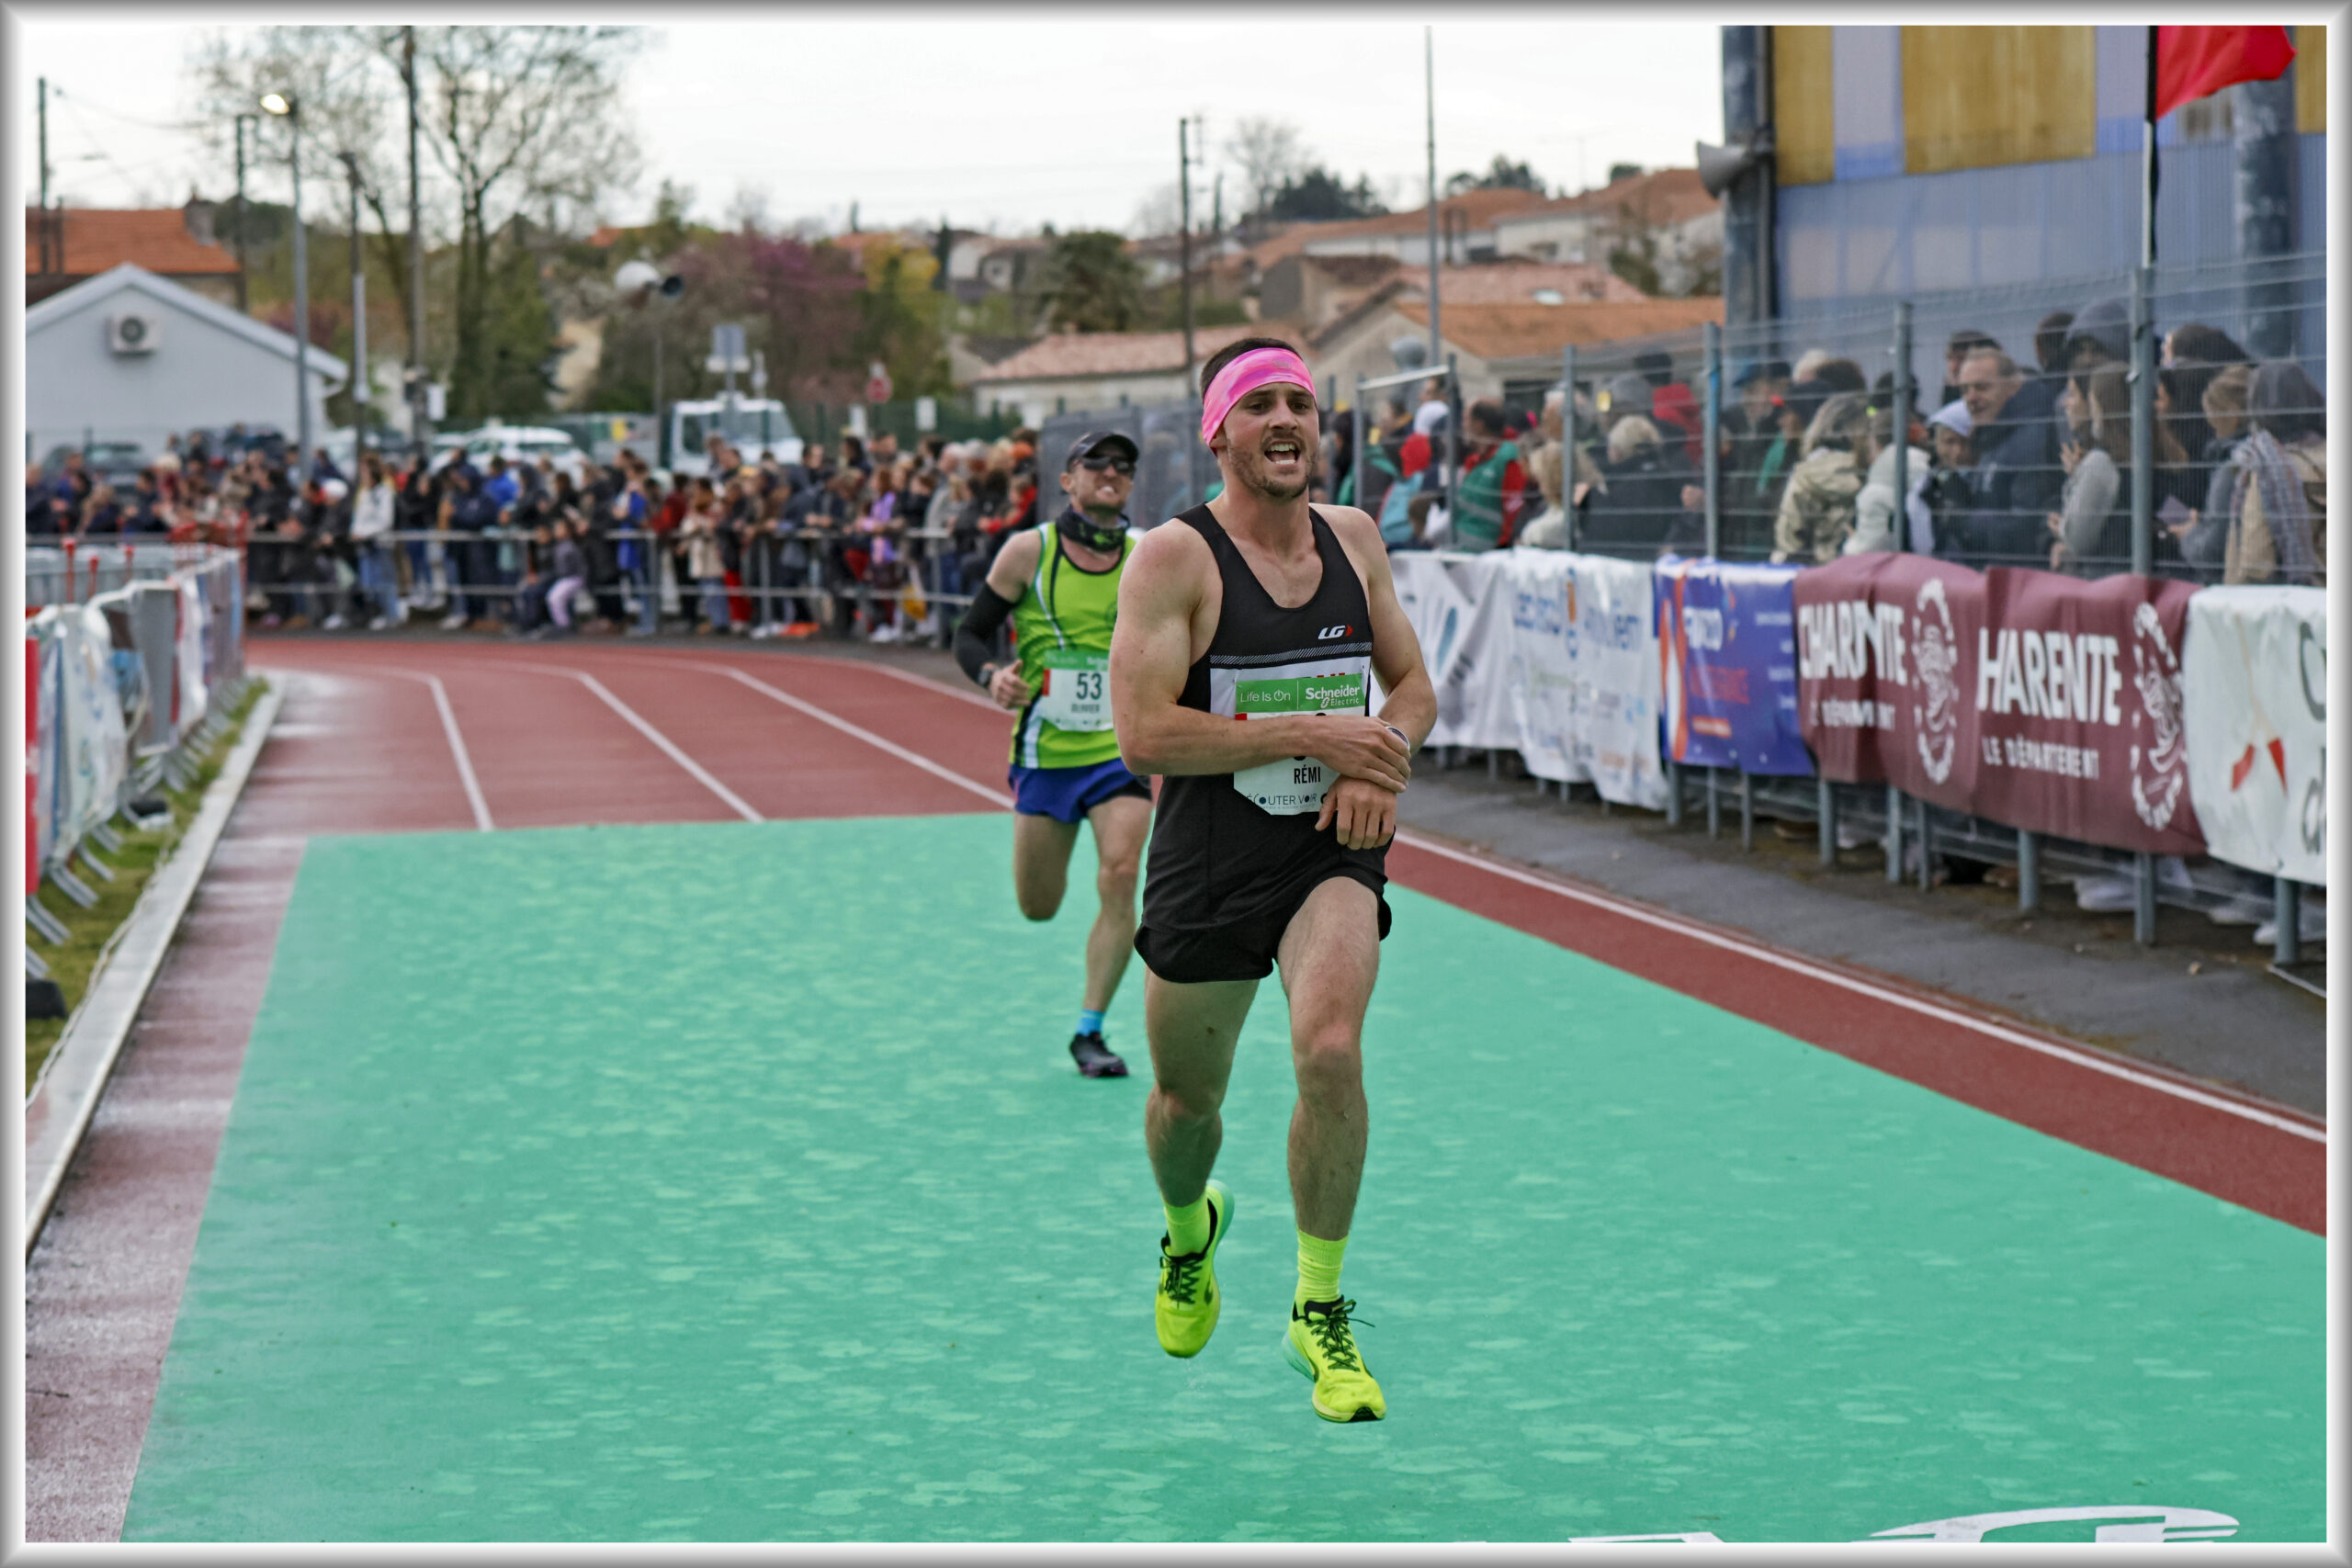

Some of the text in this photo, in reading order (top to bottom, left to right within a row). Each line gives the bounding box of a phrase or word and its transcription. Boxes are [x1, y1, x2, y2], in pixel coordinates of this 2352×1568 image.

[1076, 672, 1102, 700] 53
[1306, 684, 1360, 700] Schneider
[1240, 690, 1291, 703] Life Is On
[1330, 697, 1360, 706] Electric
[1982, 736, 2003, 766] LE
[1294, 764, 1321, 784] RÉMI
